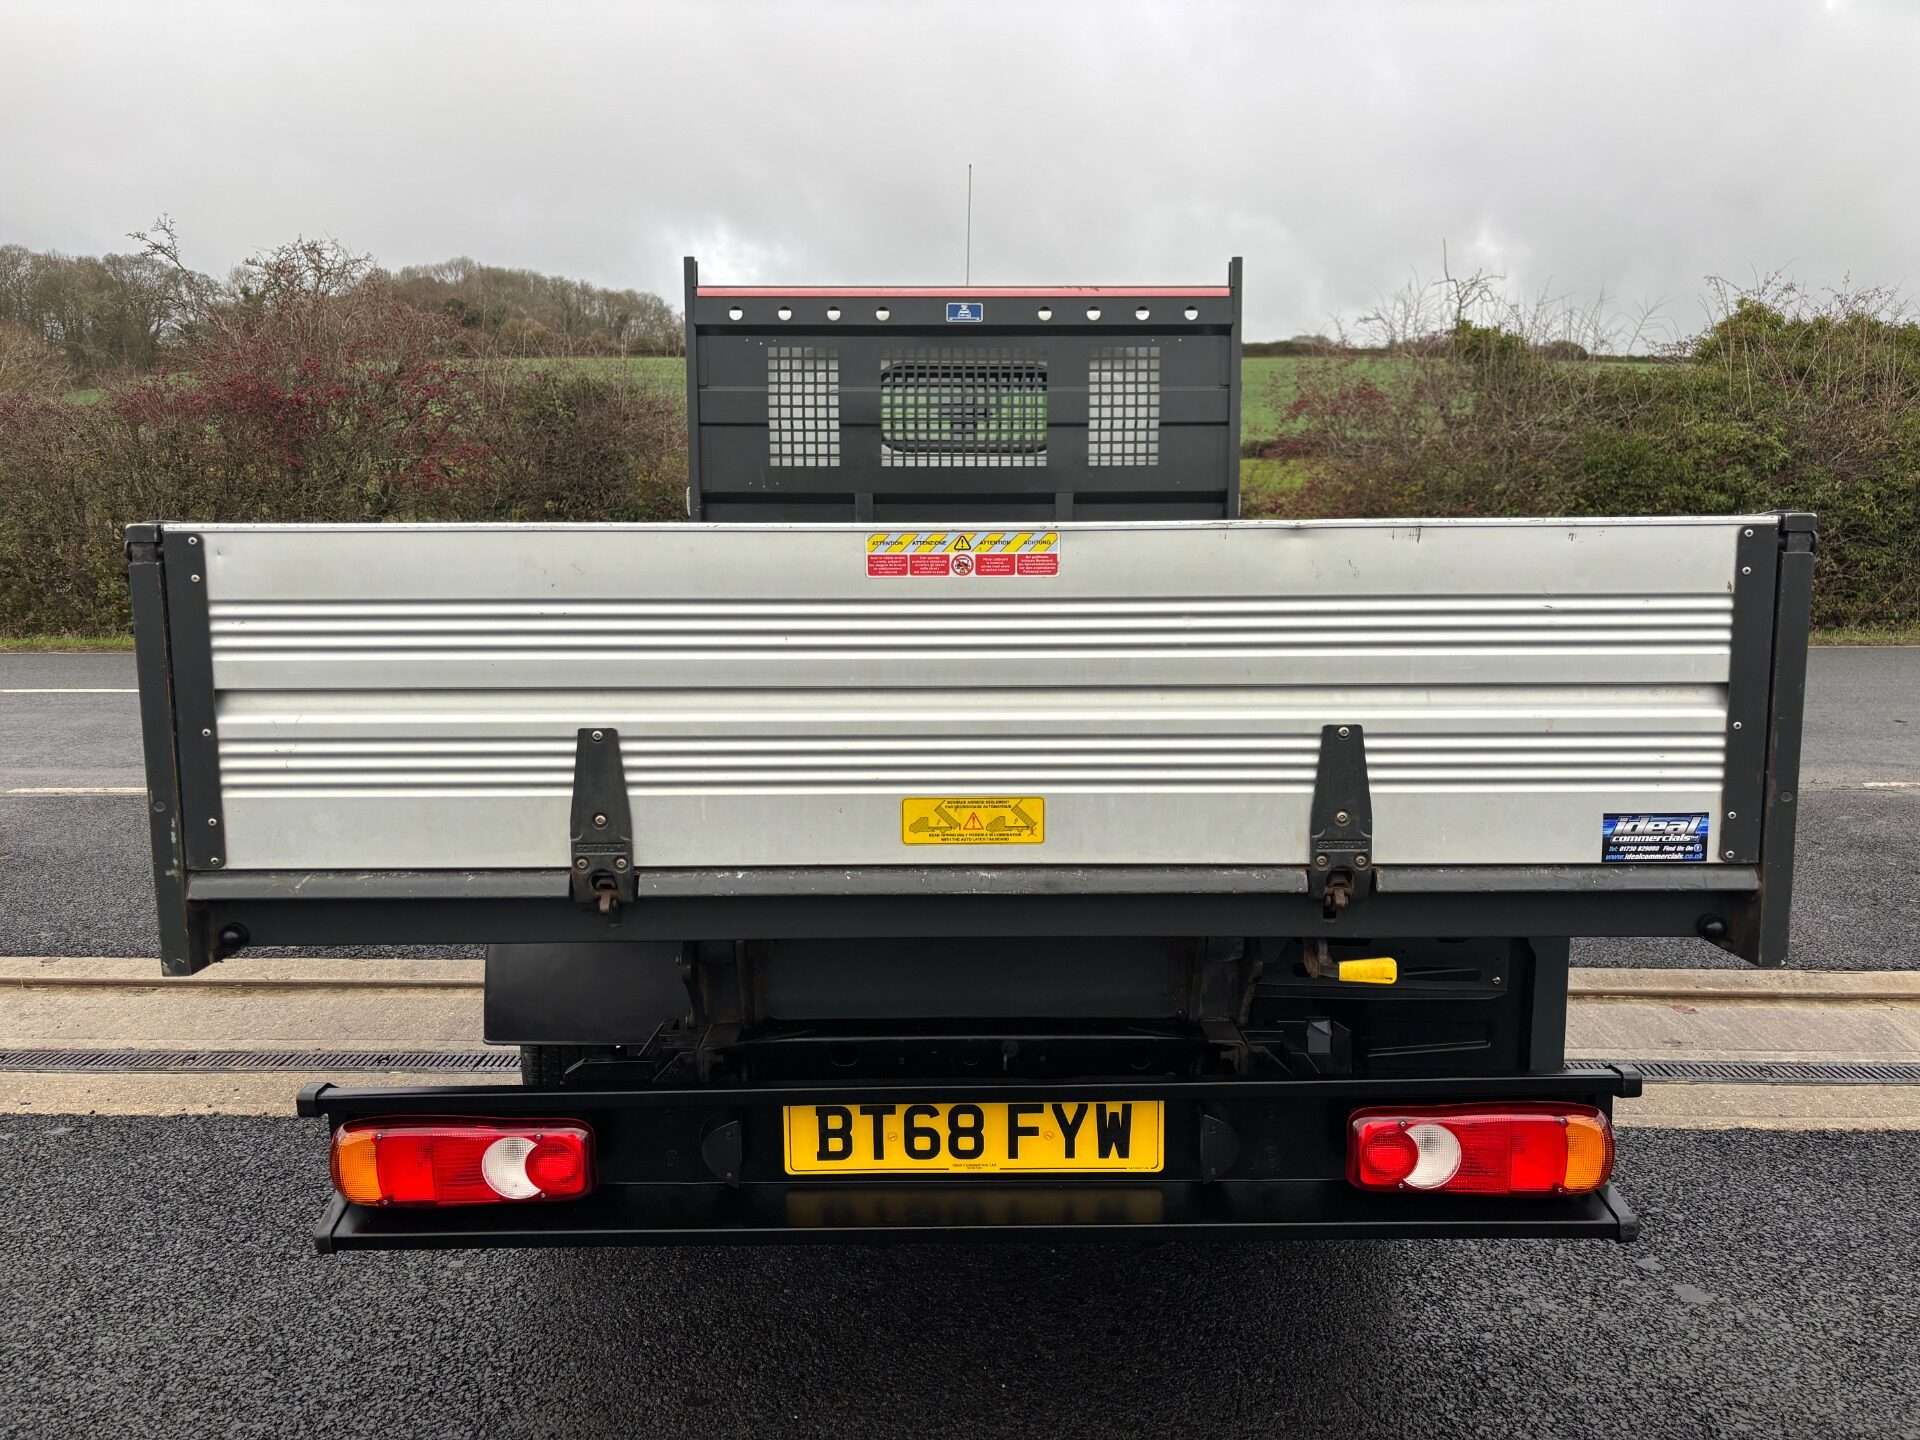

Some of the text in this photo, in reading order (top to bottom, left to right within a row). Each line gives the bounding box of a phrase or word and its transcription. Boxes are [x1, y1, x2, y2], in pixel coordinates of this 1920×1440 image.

[1613, 816, 1703, 834] ideal
[1612, 834, 1691, 842] commercials
[815, 1103, 1133, 1161] BT68 FYW
